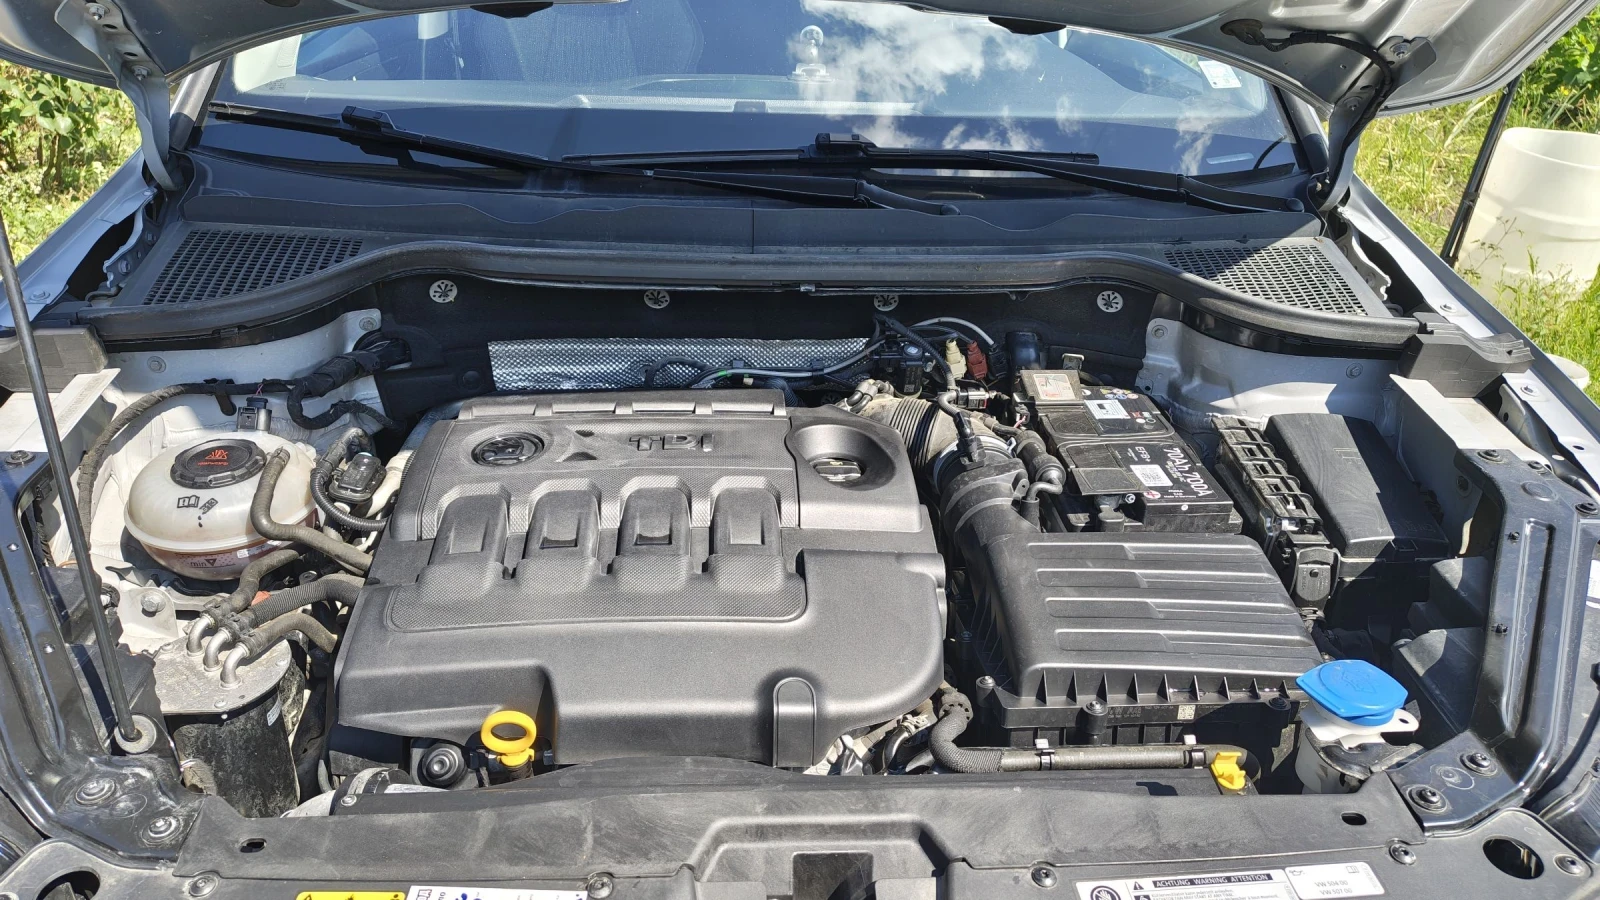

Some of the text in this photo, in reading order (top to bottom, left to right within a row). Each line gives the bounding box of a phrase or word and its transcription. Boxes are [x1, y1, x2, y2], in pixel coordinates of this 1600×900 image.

[629, 433, 715, 452] TDI
[1163, 447, 1191, 471] 70Ah
[1182, 472, 1213, 496] 700A
[1155, 874, 1269, 888] ACHTUNG WARNING ATTENTION
